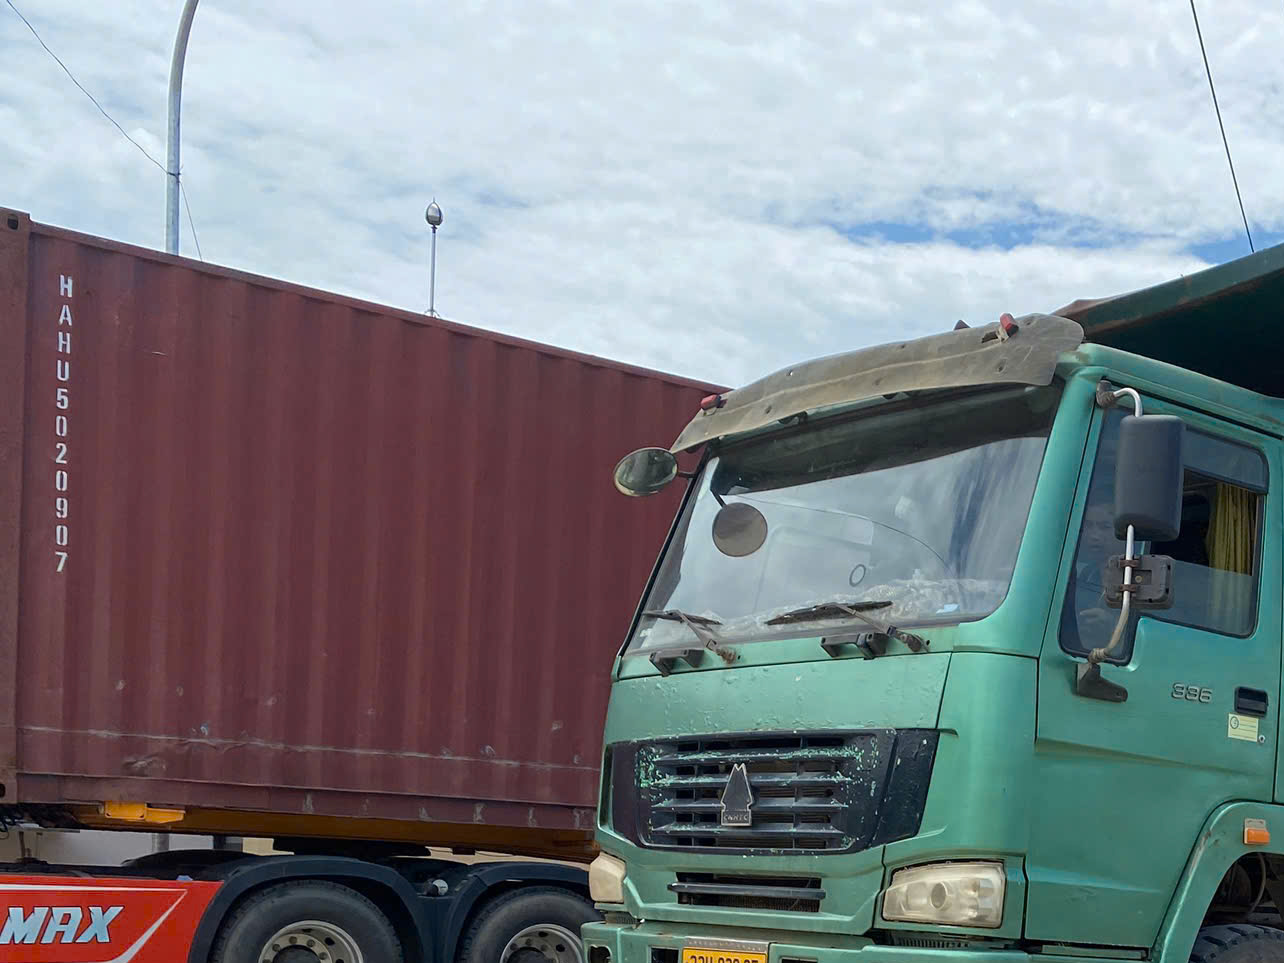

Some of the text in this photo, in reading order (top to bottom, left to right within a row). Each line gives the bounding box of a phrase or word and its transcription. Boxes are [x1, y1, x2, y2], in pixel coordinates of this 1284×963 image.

[55, 274, 73, 572] HAHU5020907
[1172, 683, 1213, 703] 336
[0, 906, 124, 943] MAX
